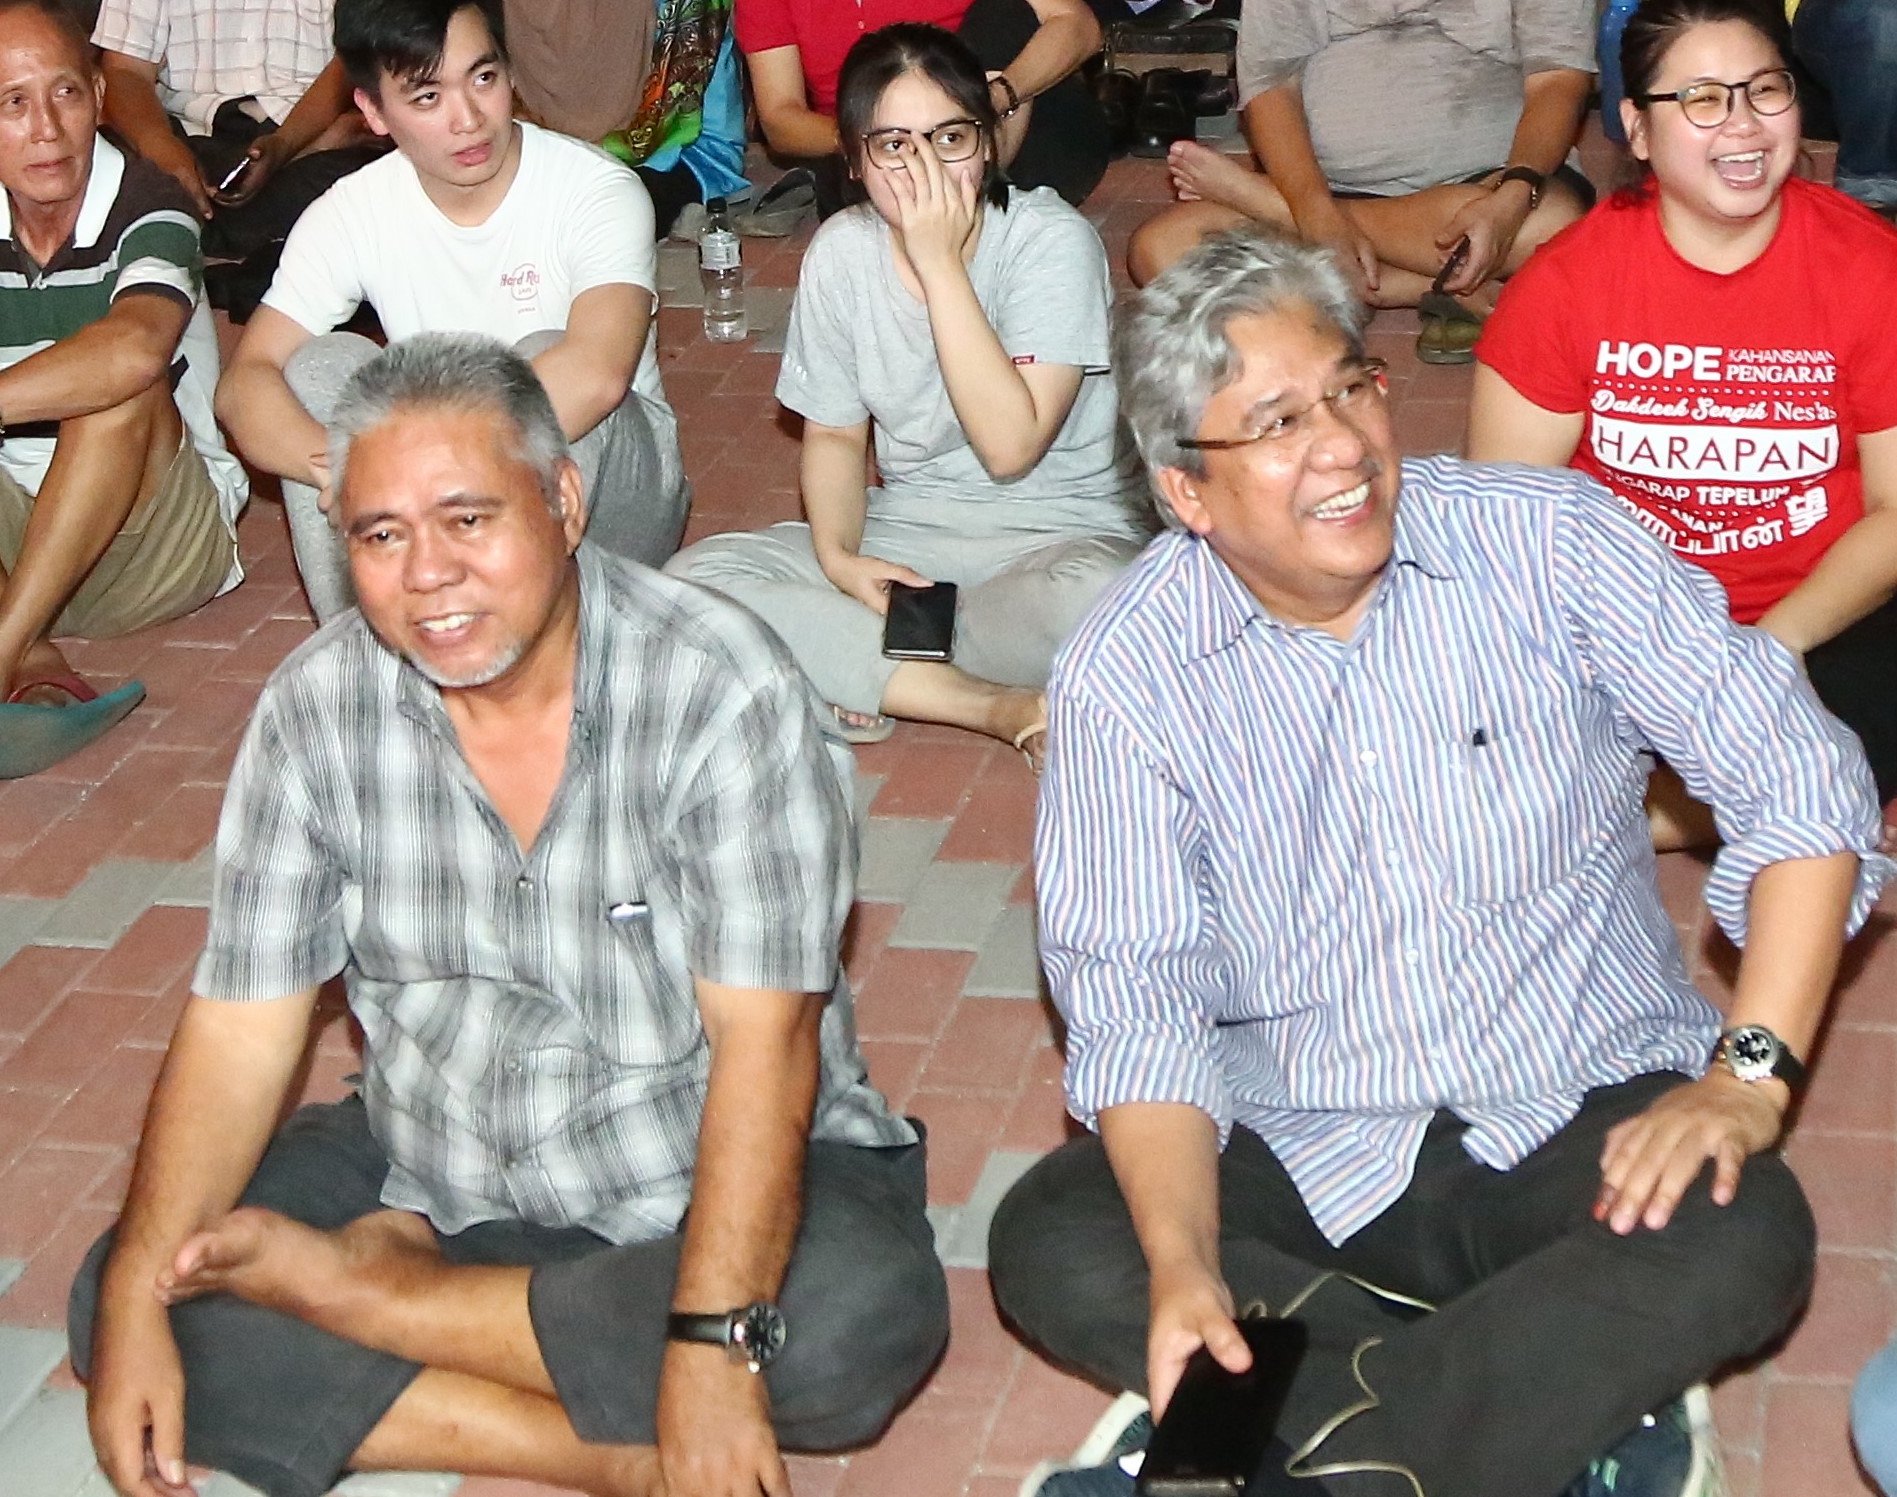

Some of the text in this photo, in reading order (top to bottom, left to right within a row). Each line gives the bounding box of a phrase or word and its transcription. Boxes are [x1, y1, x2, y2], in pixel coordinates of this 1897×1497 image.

[1595, 340, 1723, 381] HOPE
[1691, 396, 1769, 423] Sengik
[1597, 425, 1832, 474] HARAPAN
